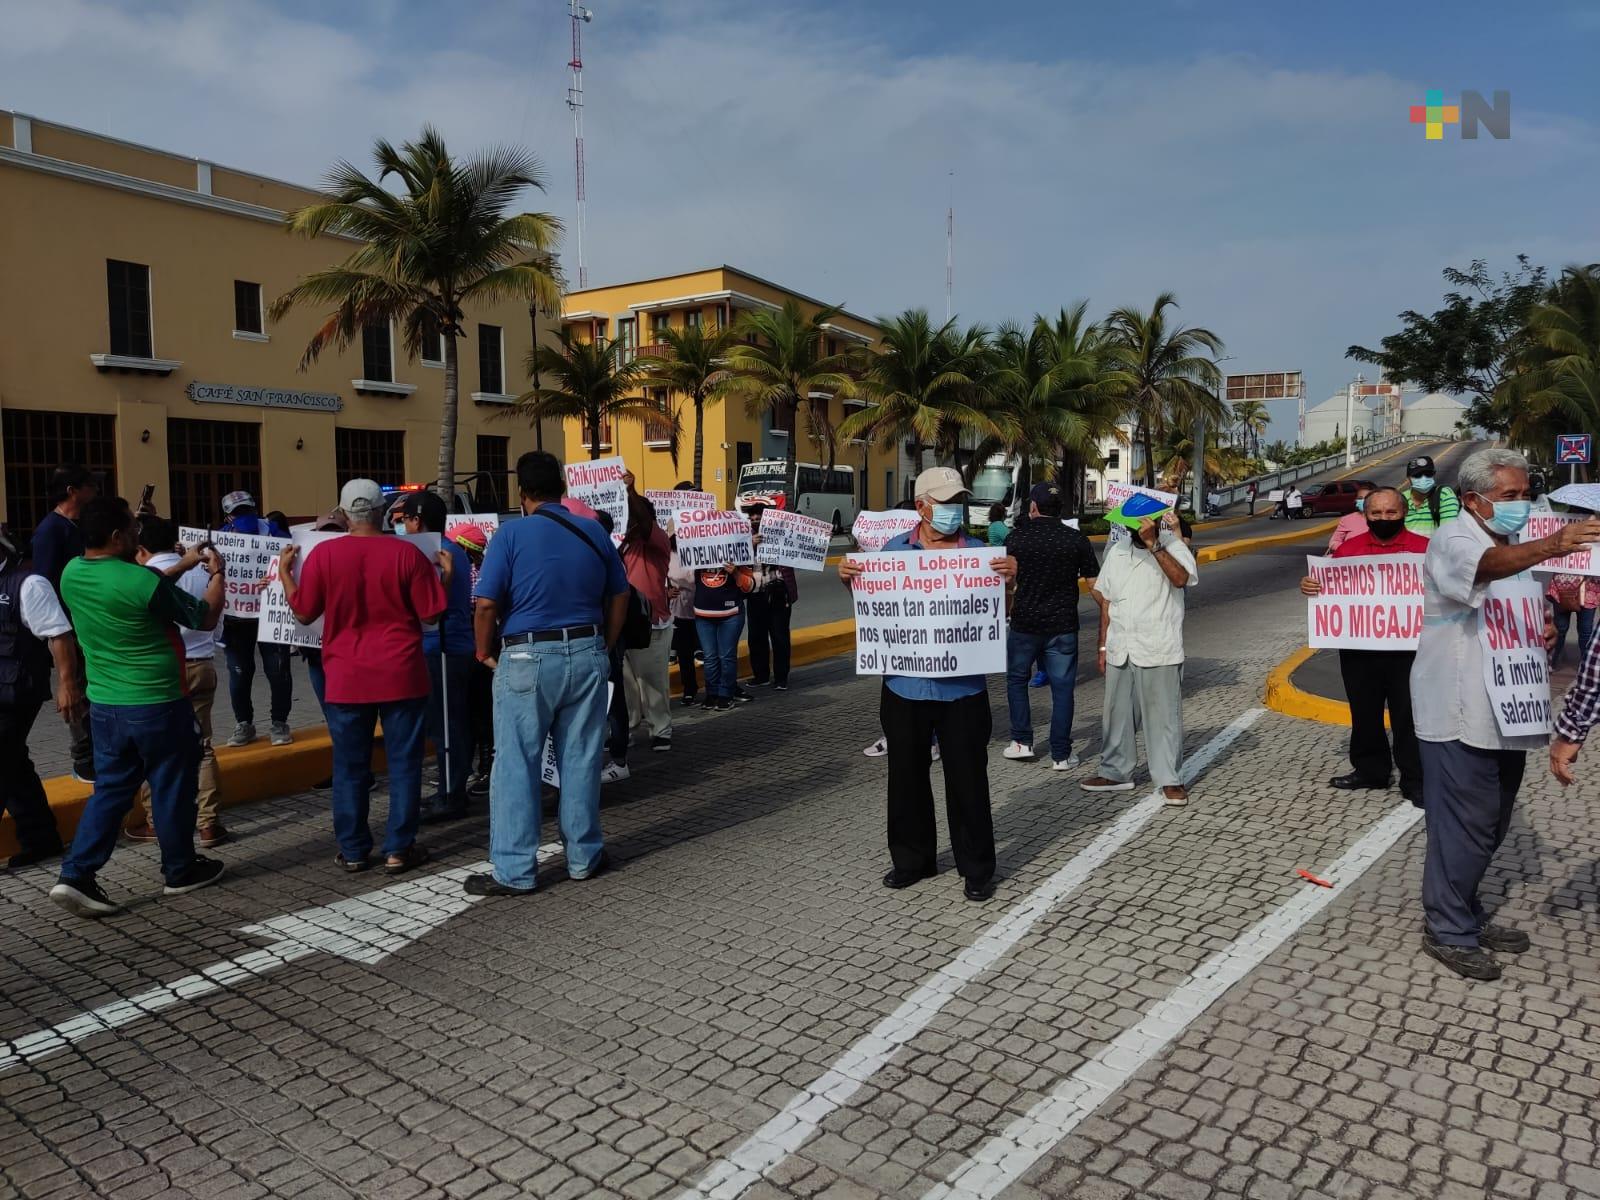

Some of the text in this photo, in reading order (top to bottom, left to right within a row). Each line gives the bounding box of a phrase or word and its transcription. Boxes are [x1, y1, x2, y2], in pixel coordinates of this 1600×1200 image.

[196, 385, 336, 408] CAFÉ SAN FRANCISCO
[567, 465, 624, 489] Chikiyunes
[645, 490, 681, 499] QUEREMOS
[653, 500, 715, 510] ONESTAMENTE
[763, 510, 799, 522] QUEREMOS
[677, 521, 750, 540] COMERCIANTES
[761, 524, 786, 536] Tenemos
[788, 529, 794, 539] 2
[251, 538, 260, 549] tu
[265, 540, 280, 551] vas
[680, 541, 752, 567] NO DELINCUENTES.
[228, 565, 239, 578] de
[240, 566, 253, 579] las
[918, 554, 980, 572] Lobeira
[852, 573, 1001, 595] Miguel Angel Yunes
[266, 587, 277, 606] Ya
[857, 593, 1000, 618] no sean tan animales y
[1315, 604, 1425, 639] NO MIGAJA
[1483, 598, 1523, 651] SRA
[273, 625, 282, 641] el
[859, 619, 1000, 648] nos quieran mandar al
[860, 649, 958, 674] sol y caminando
[1492, 655, 1506, 687] la
[1508, 654, 1543, 686] invito
[1500, 692, 1543, 725] salario
[543, 768, 554, 782] no
